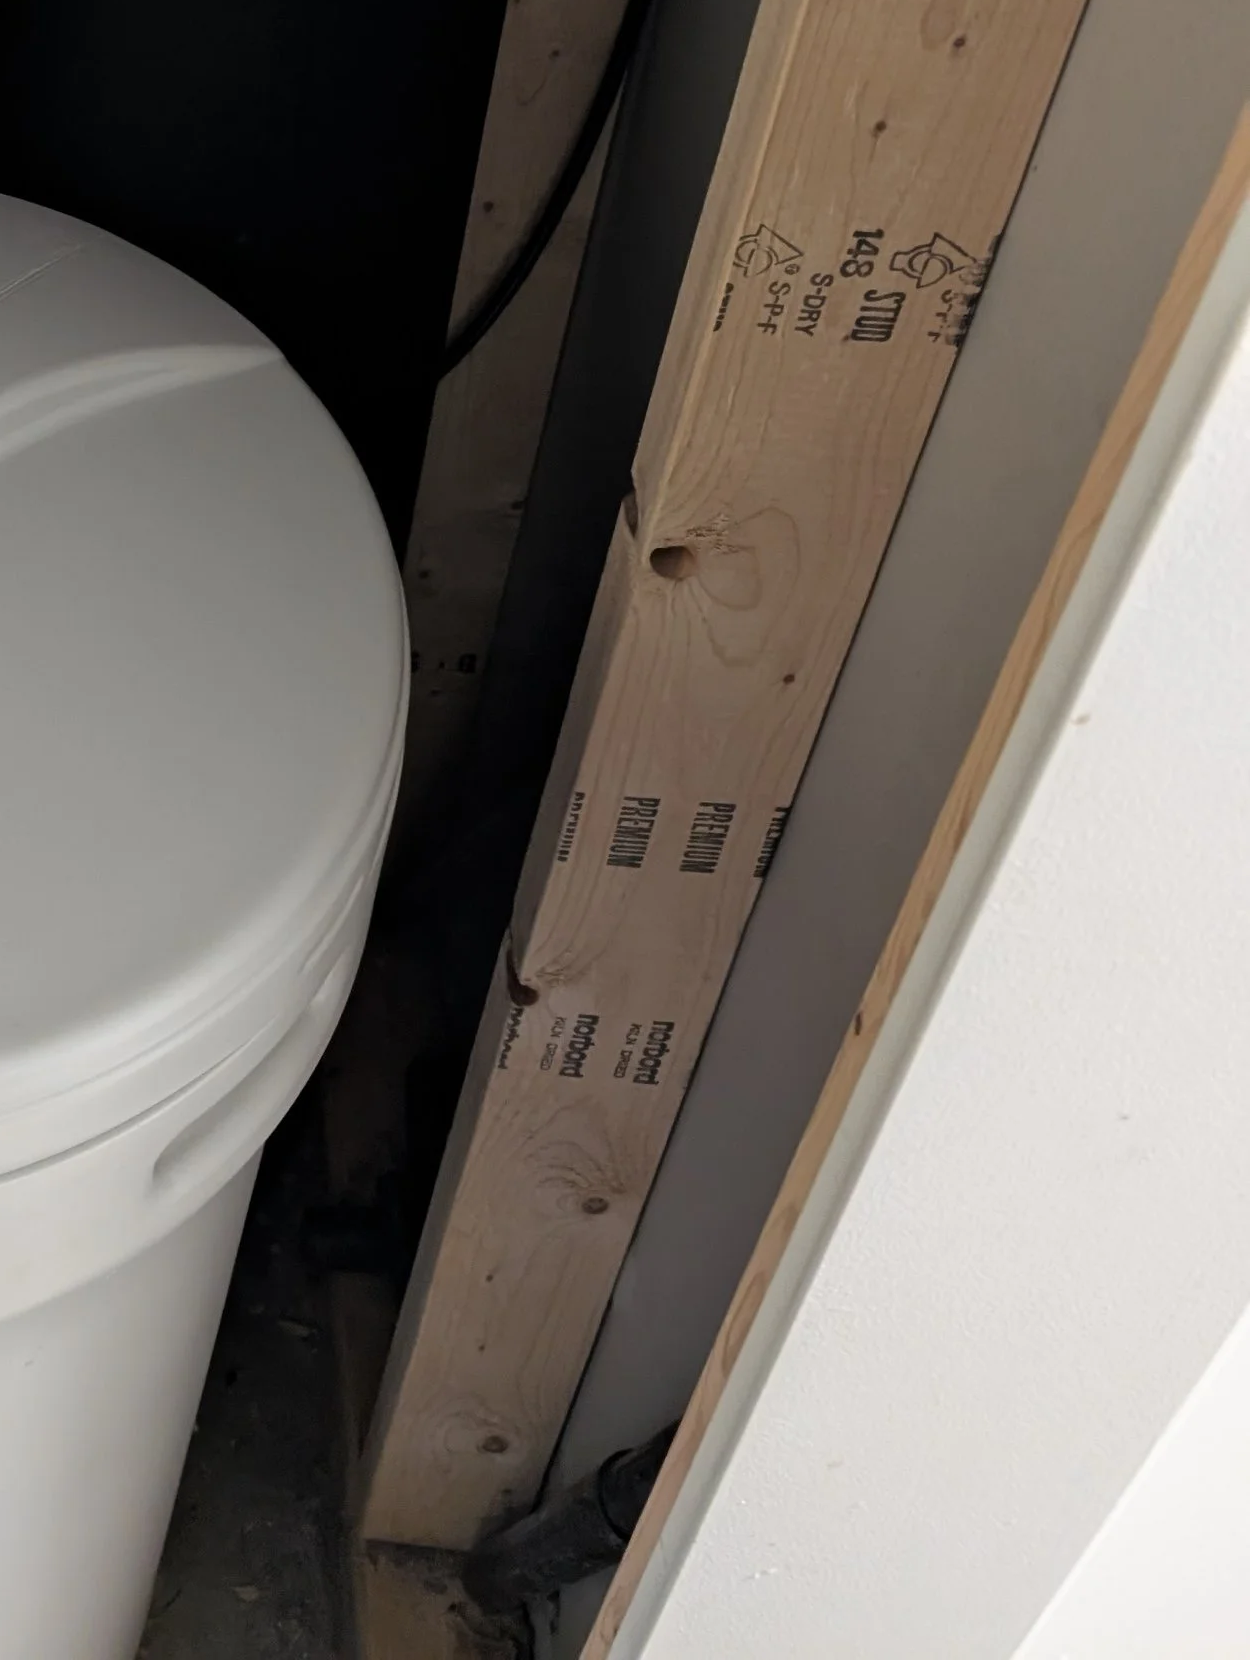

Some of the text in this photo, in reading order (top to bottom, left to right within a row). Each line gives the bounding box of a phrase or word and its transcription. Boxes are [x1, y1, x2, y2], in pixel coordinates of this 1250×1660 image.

[839, 227, 885, 278] 148
[757, 280, 792, 336] S-P-F
[794, 272, 834, 338] S-DRY
[850, 289, 906, 343] STUD
[606, 796, 662, 869] PREMIUM
[679, 801, 737, 874] PREMIUM
[558, 1013, 600, 1079] norbord
[632, 1020, 675, 1086] norbord
